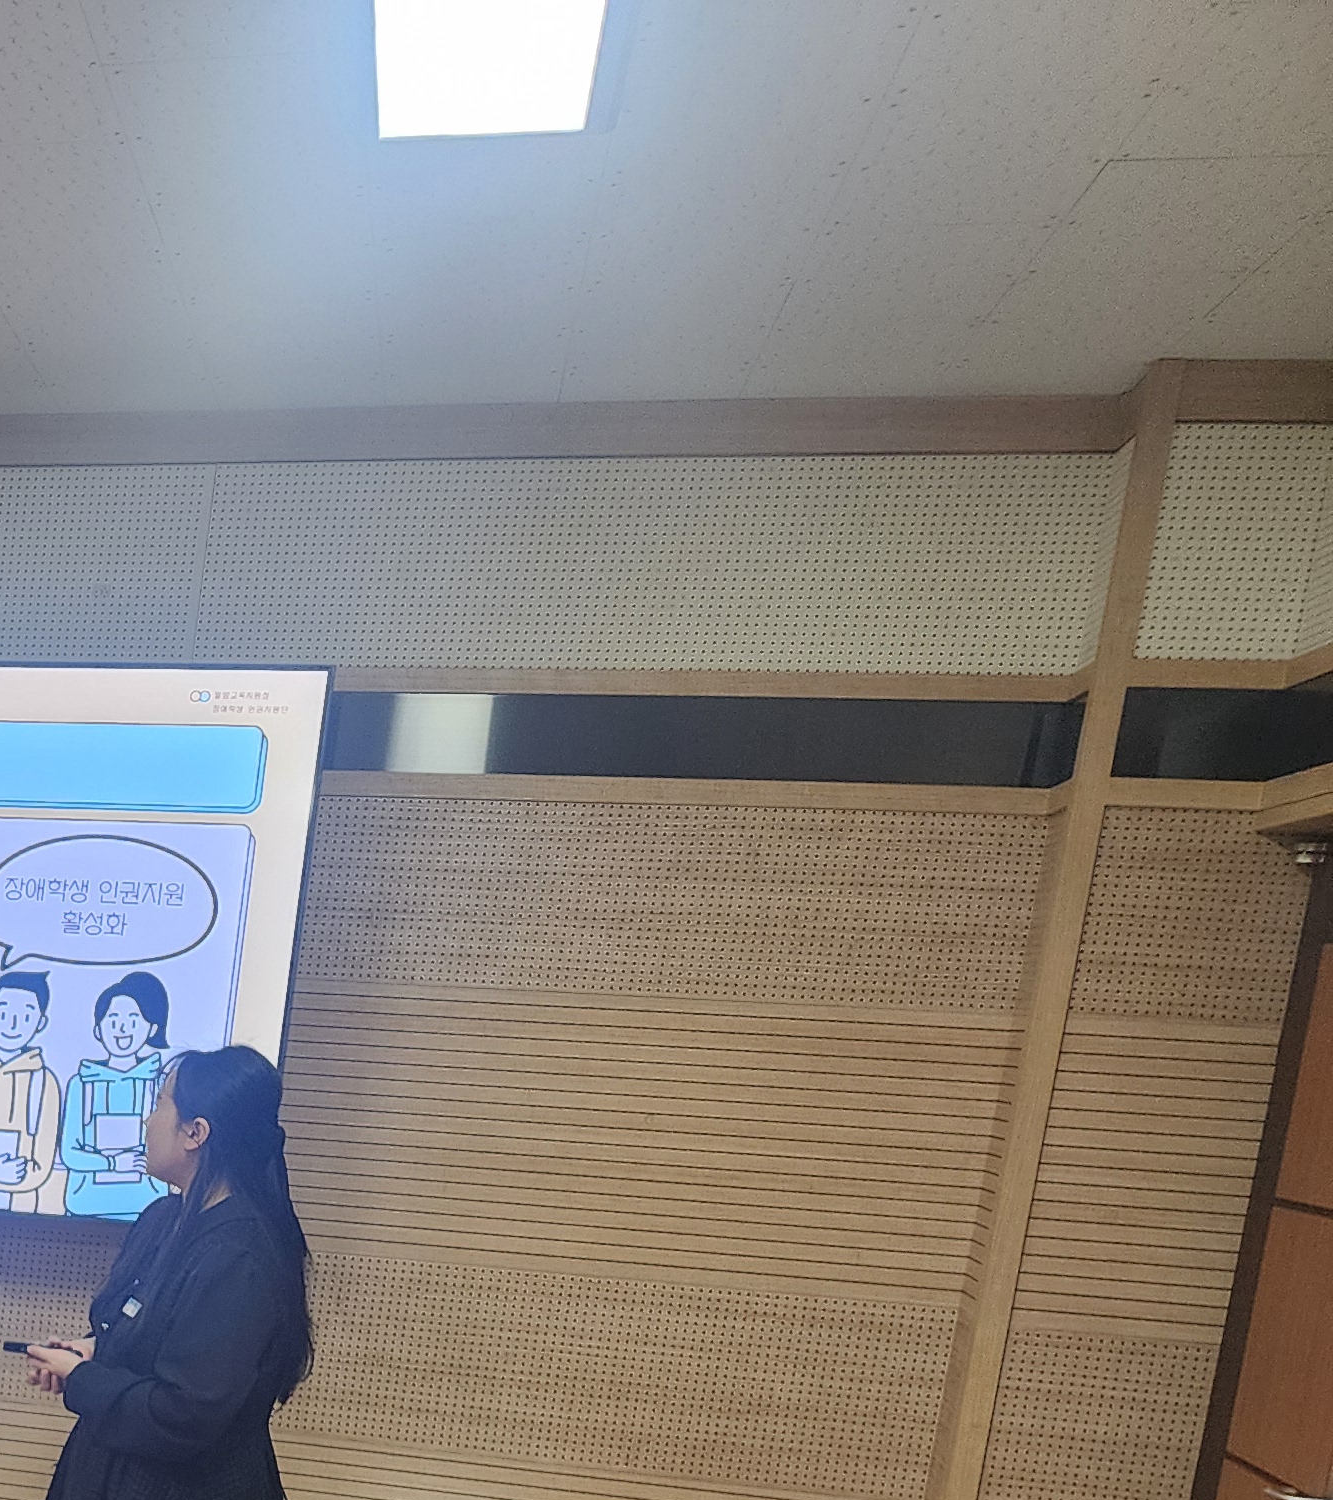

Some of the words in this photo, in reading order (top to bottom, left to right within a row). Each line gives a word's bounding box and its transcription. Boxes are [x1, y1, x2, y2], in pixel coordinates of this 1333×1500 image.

[4, 877, 90, 904] 장애학생
[98, 880, 185, 906] 인권지원
[60, 910, 128, 936] 활성화
